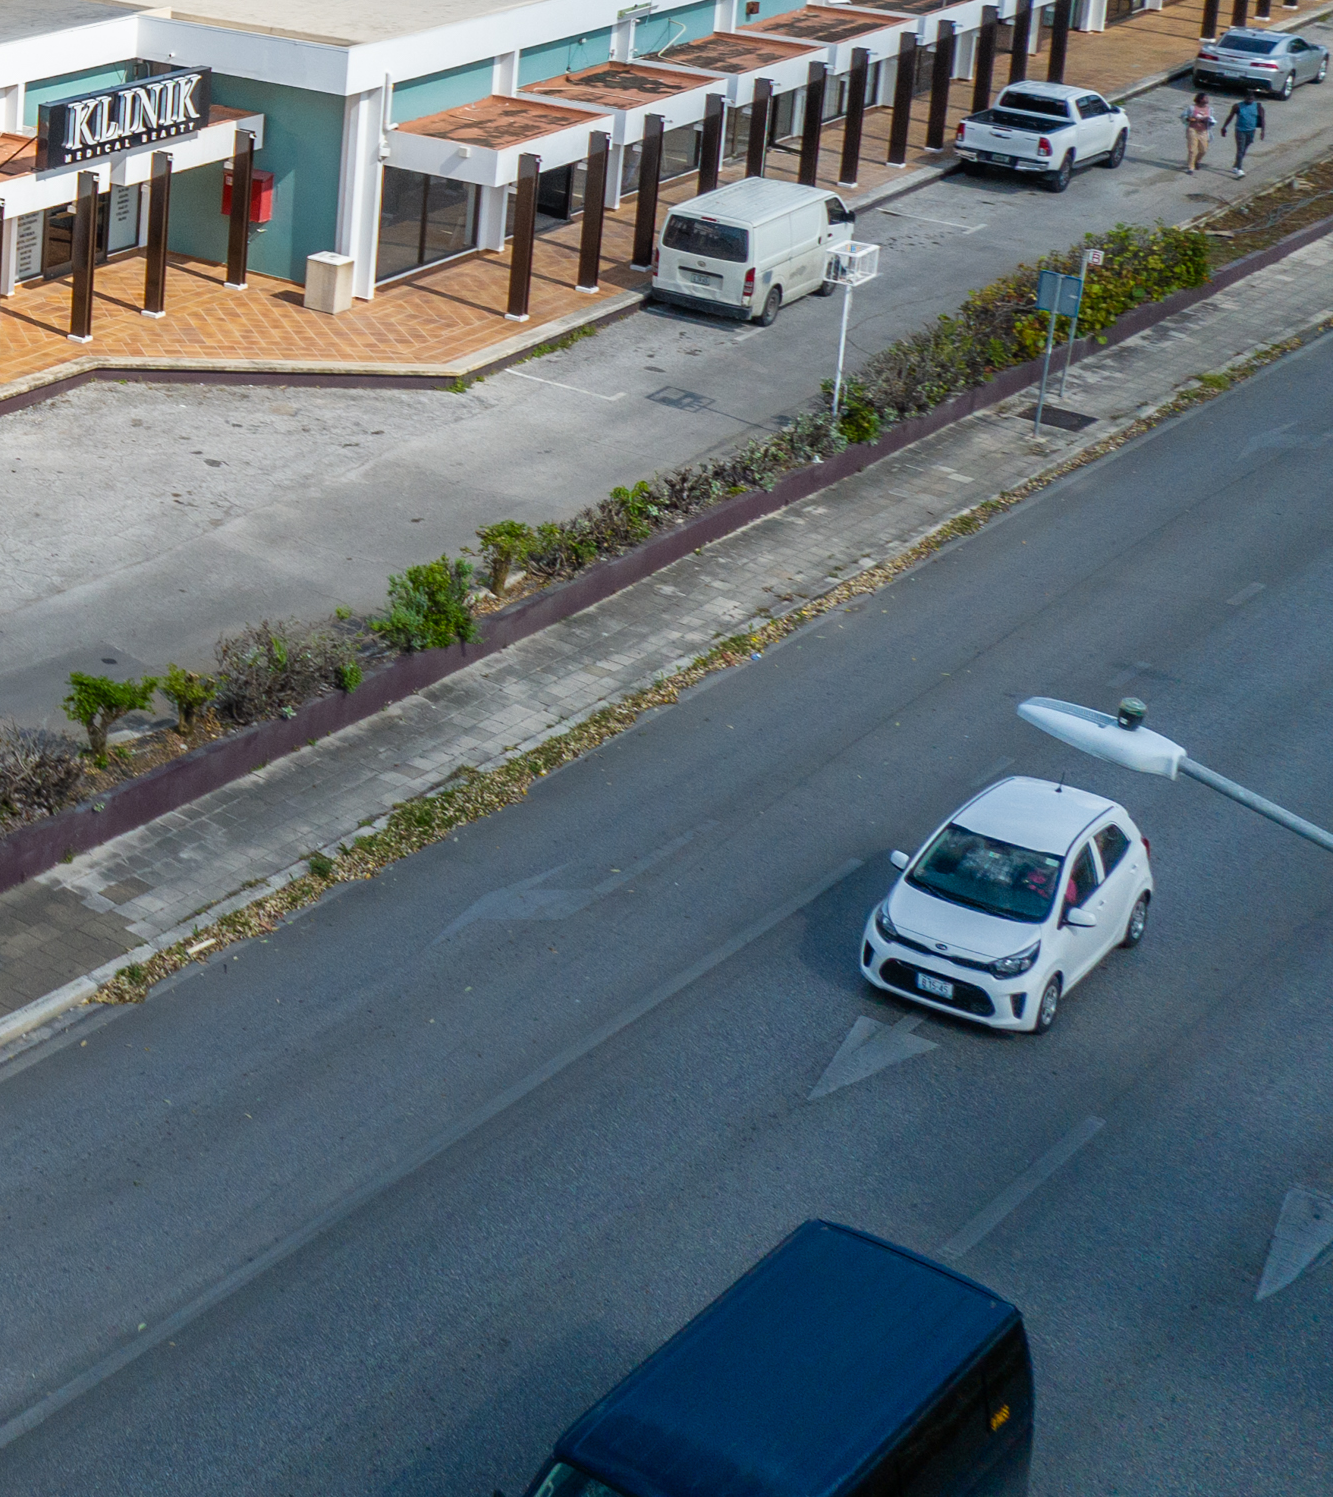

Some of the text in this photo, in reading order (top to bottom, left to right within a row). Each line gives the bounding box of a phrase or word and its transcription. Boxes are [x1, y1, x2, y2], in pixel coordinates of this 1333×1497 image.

[66, 73, 202, 150] KLINIK
[64, 122, 196, 164] MEDICAL BEAUTY
